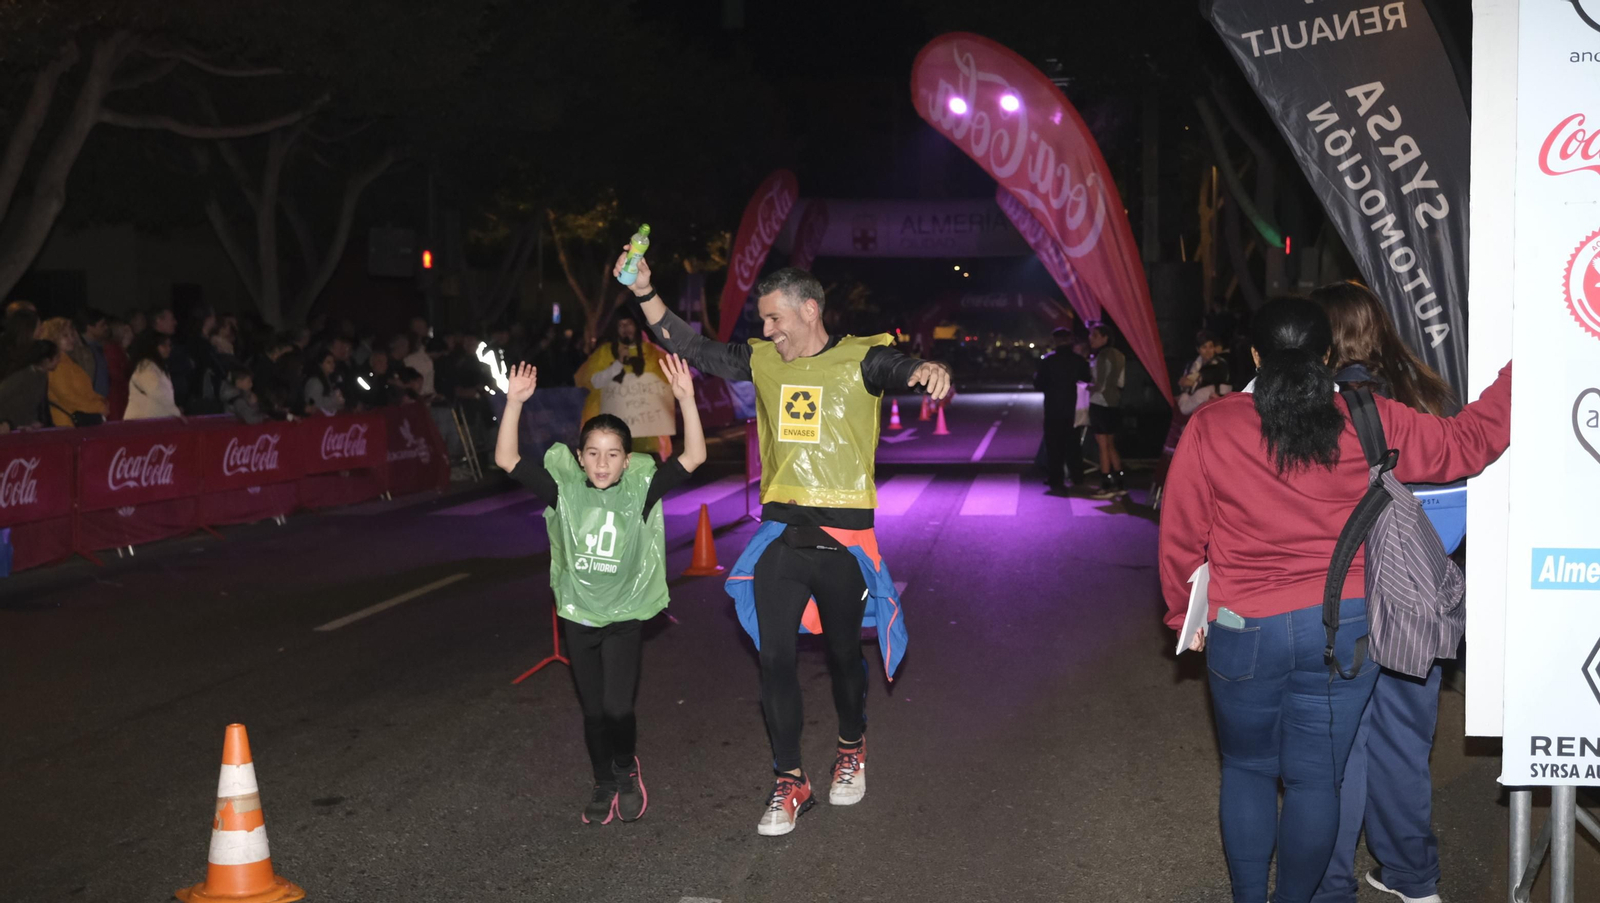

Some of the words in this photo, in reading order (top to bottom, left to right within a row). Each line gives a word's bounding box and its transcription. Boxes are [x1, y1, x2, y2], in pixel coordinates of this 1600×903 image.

[783, 428, 815, 437] ENVASES
[593, 561, 618, 574] VIDRIO
[1538, 554, 1600, 584] Alme
[1530, 735, 1600, 757] REN
[1530, 762, 1580, 779] SYRSA
